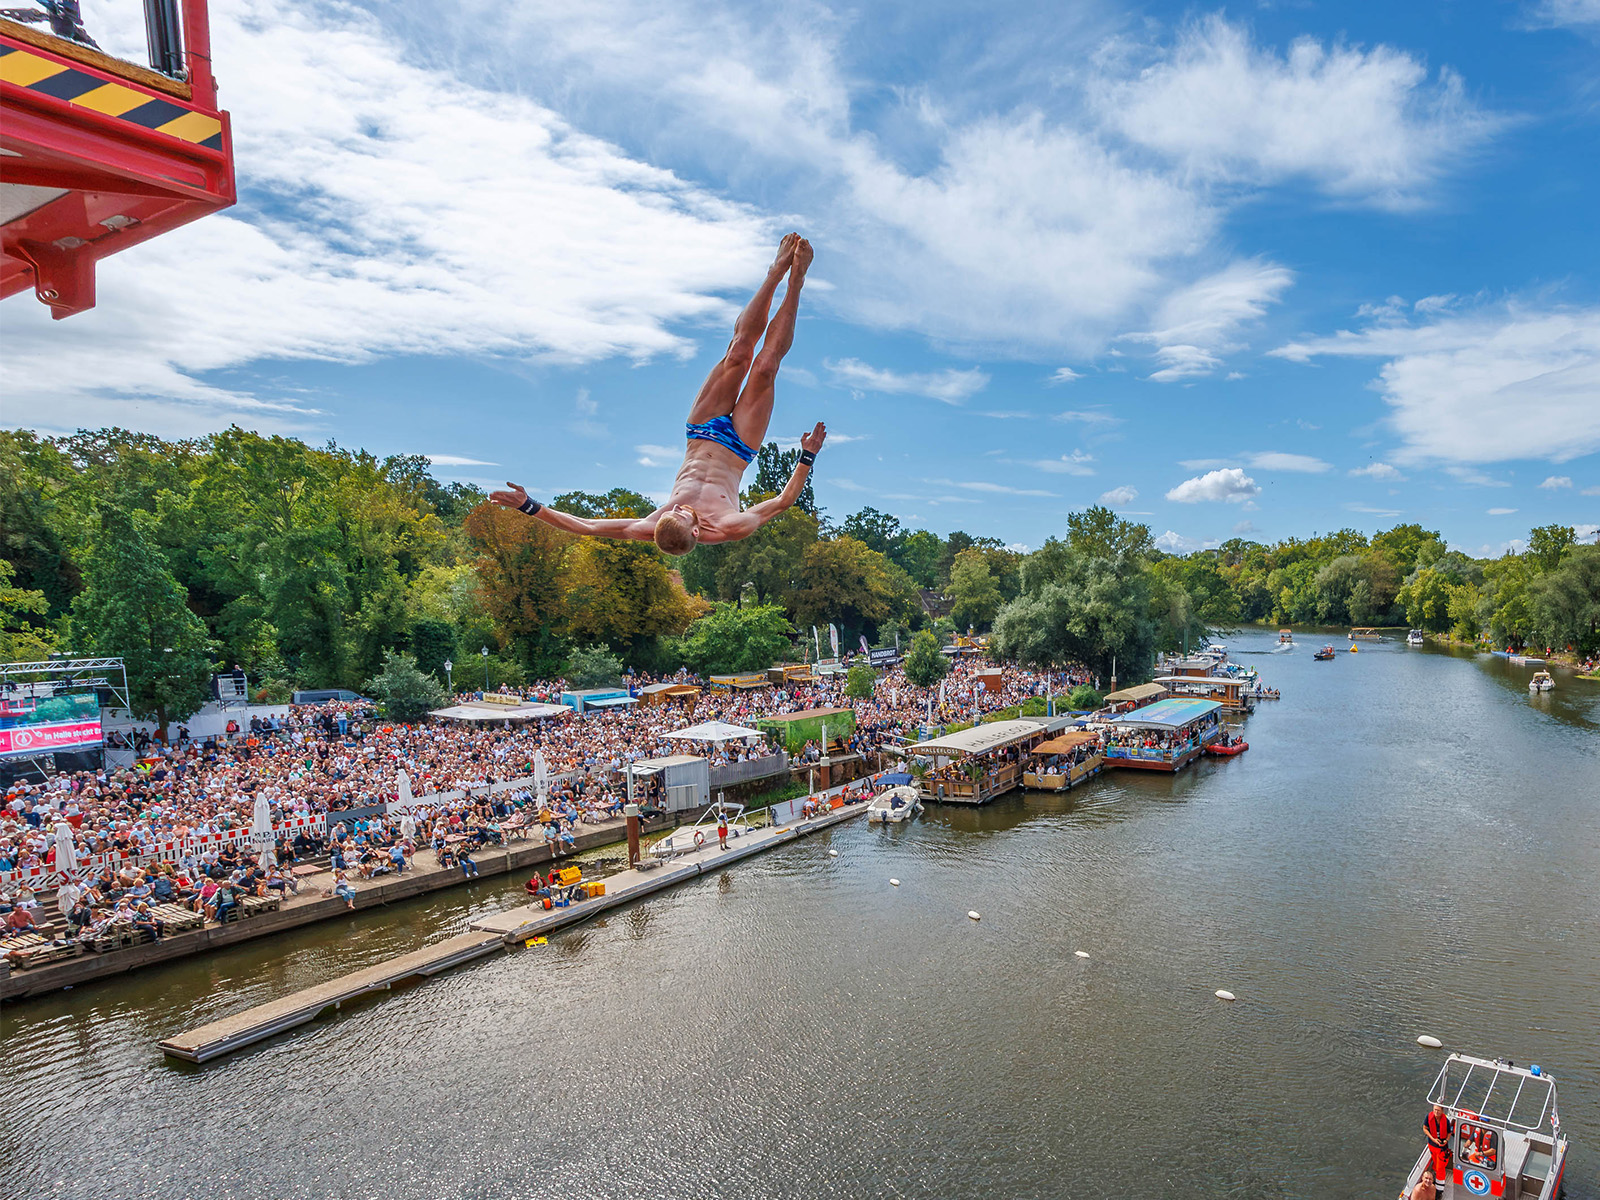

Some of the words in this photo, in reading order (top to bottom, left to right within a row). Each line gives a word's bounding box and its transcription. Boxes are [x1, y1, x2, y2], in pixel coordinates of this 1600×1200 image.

[871, 650, 896, 658] HANDBROT
[53, 730, 72, 739] Halle
[73, 728, 93, 737] steckt
[965, 724, 1032, 748] HALLEFLOSS
[920, 747, 959, 755] HALLEFLOSS
